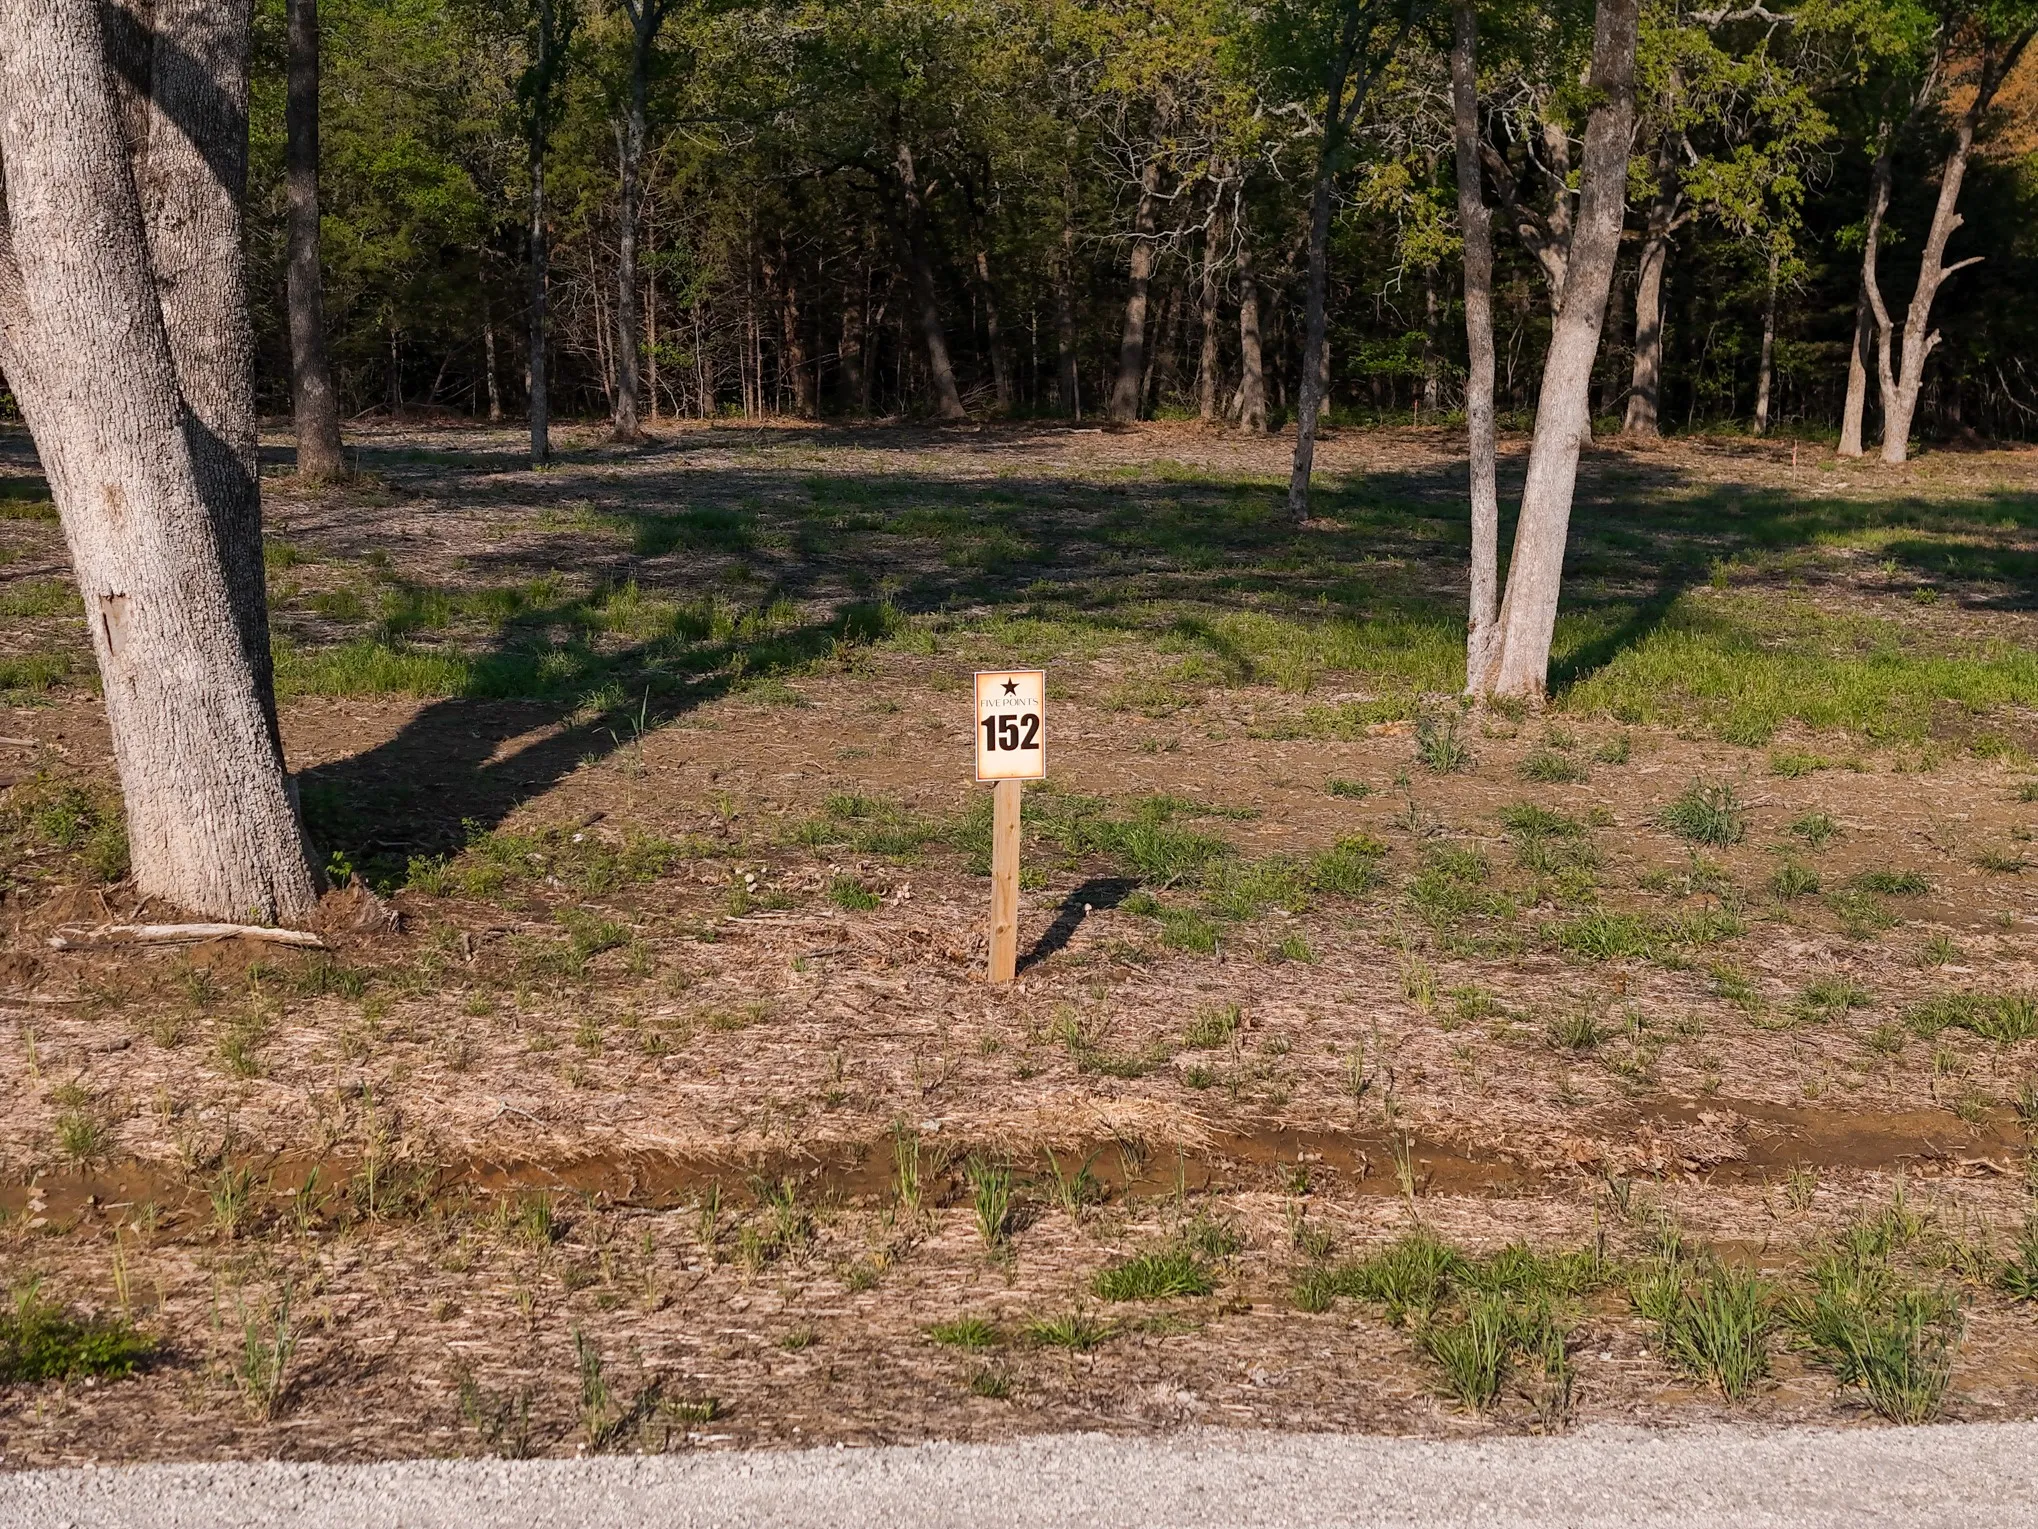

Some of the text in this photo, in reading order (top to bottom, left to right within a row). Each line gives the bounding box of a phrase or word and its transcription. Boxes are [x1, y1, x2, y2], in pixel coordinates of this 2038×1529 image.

[980, 698, 1039, 707] FIVE POINTS
[981, 713, 1039, 751] 152
